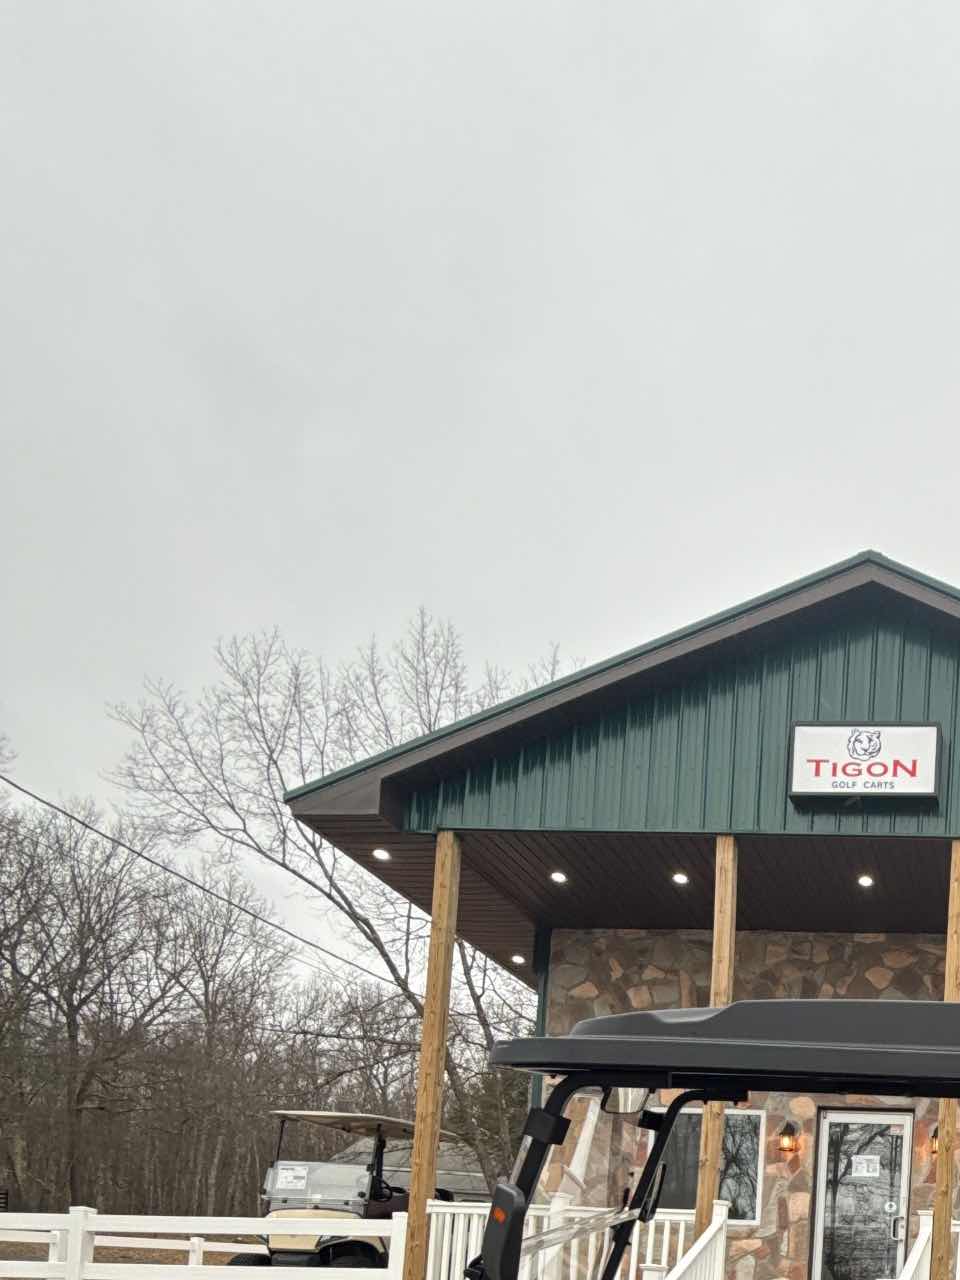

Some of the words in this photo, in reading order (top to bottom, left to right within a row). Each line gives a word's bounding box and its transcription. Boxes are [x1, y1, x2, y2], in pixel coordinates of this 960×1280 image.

[806, 759, 918, 778] TIGON
[831, 781, 857, 789] GOLF
[863, 781, 895, 789] CARTS
